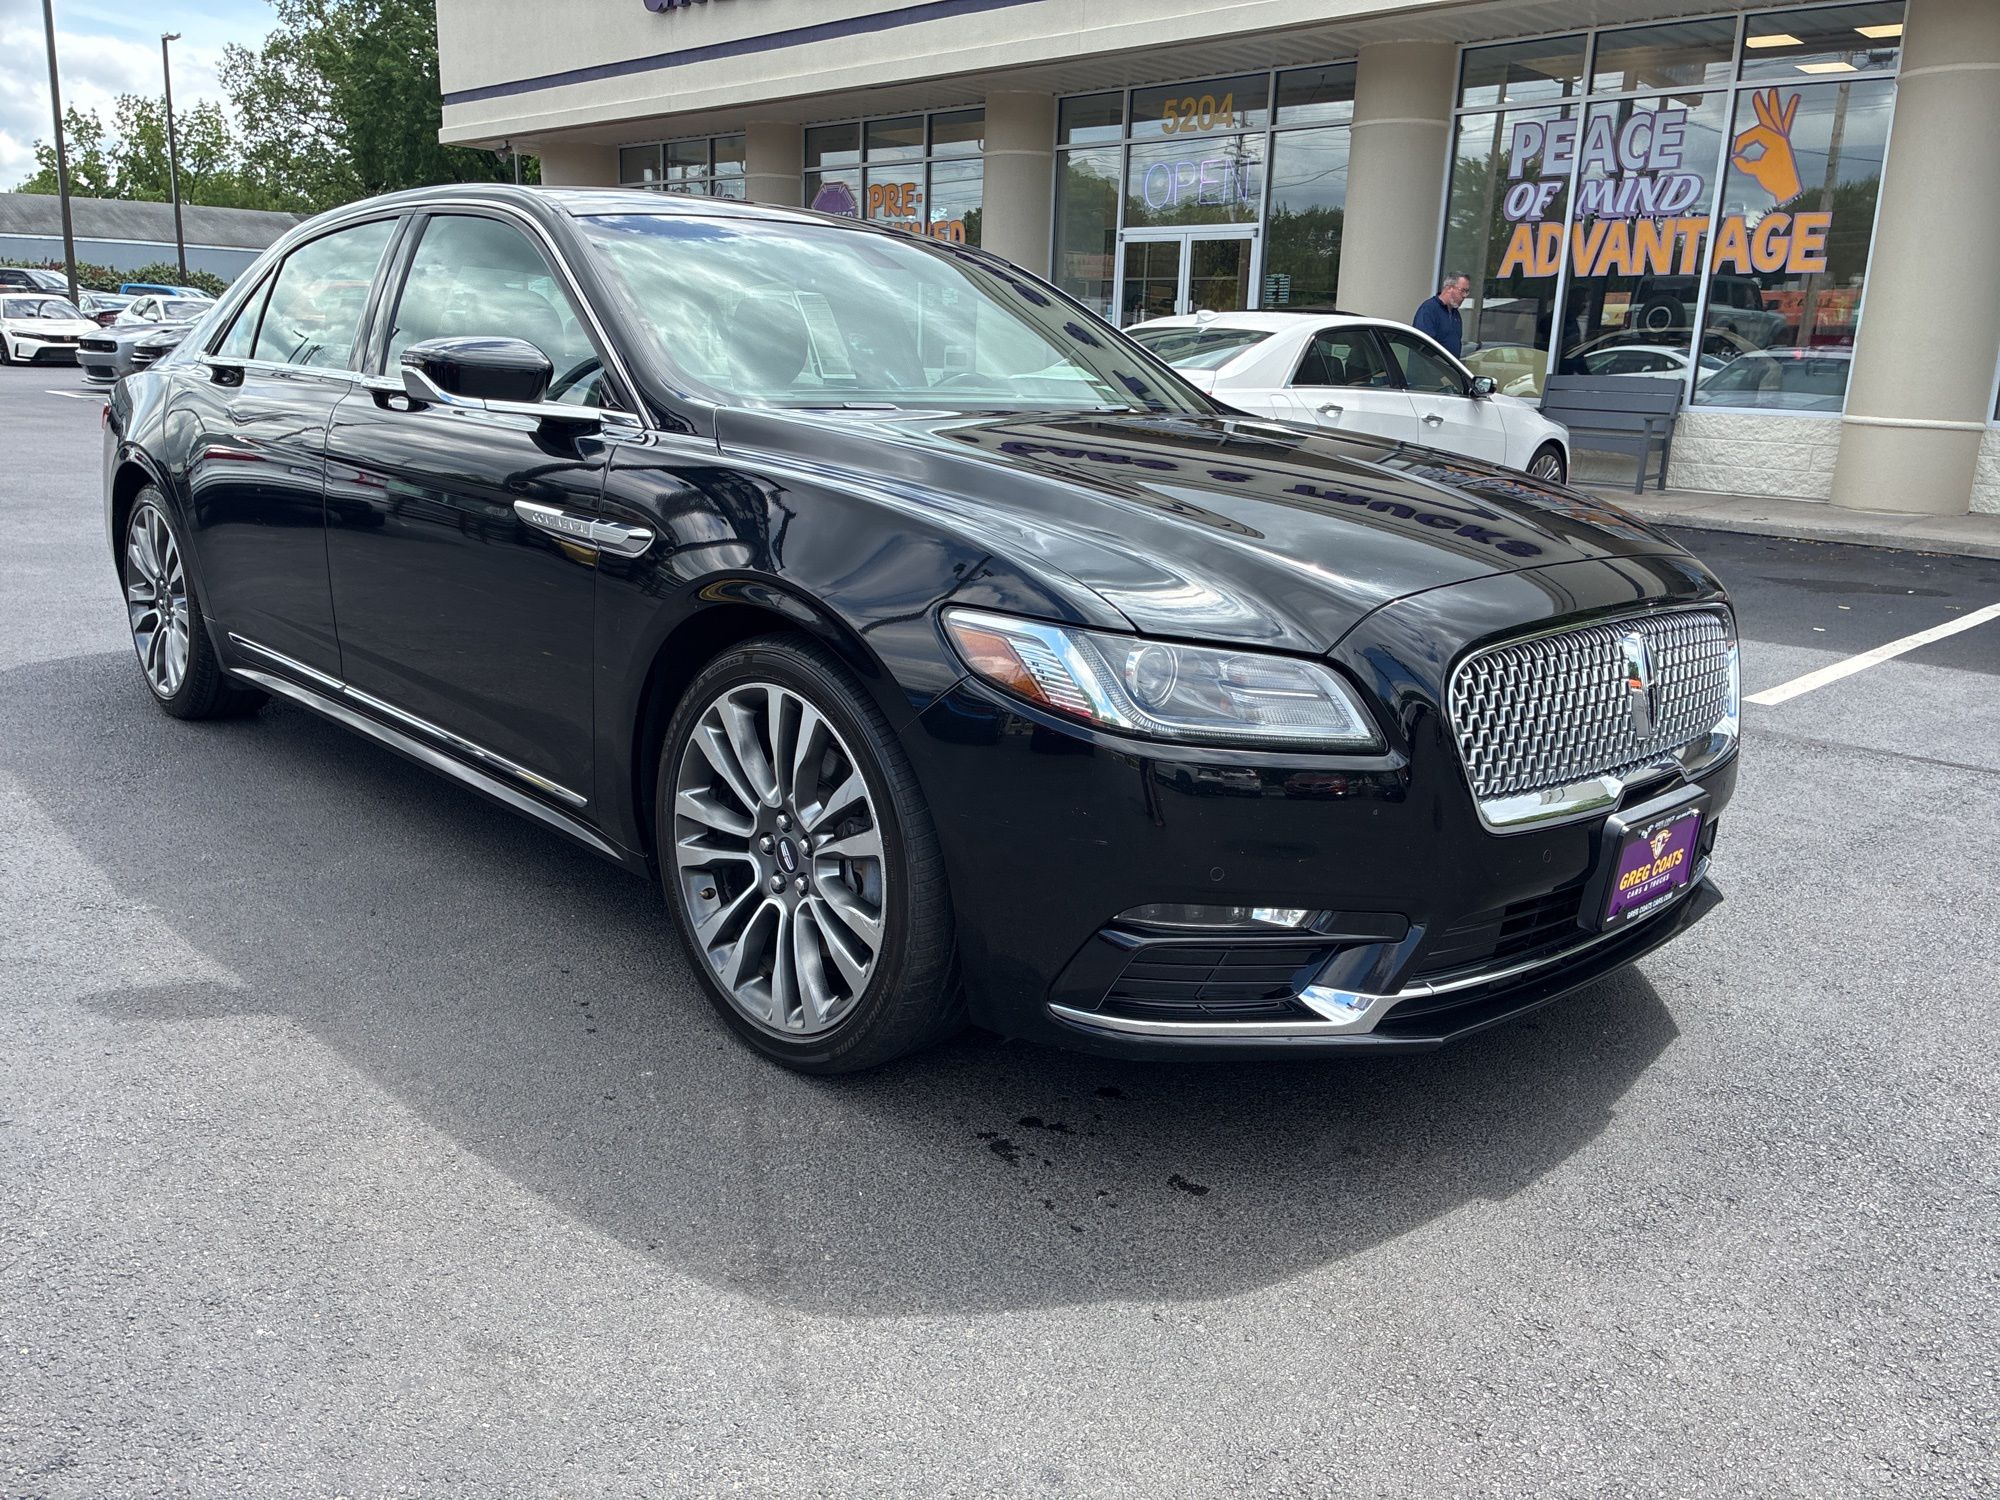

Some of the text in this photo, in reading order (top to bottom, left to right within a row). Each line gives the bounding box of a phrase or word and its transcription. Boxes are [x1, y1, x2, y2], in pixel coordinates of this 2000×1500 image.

[1162, 93, 1233, 134] 5204
[1508, 109, 1687, 179] PEACE
[867, 182, 923, 219] PRE-
[1145, 160, 1250, 208] OPEN
[1504, 174, 1704, 221] OF MIND
[1497, 212, 1833, 278] ADVANTAGE
[1619, 848, 1684, 890] GREG COATS
[1626, 886, 1643, 899] CARS
[1649, 873, 1670, 889] TRUCKS
